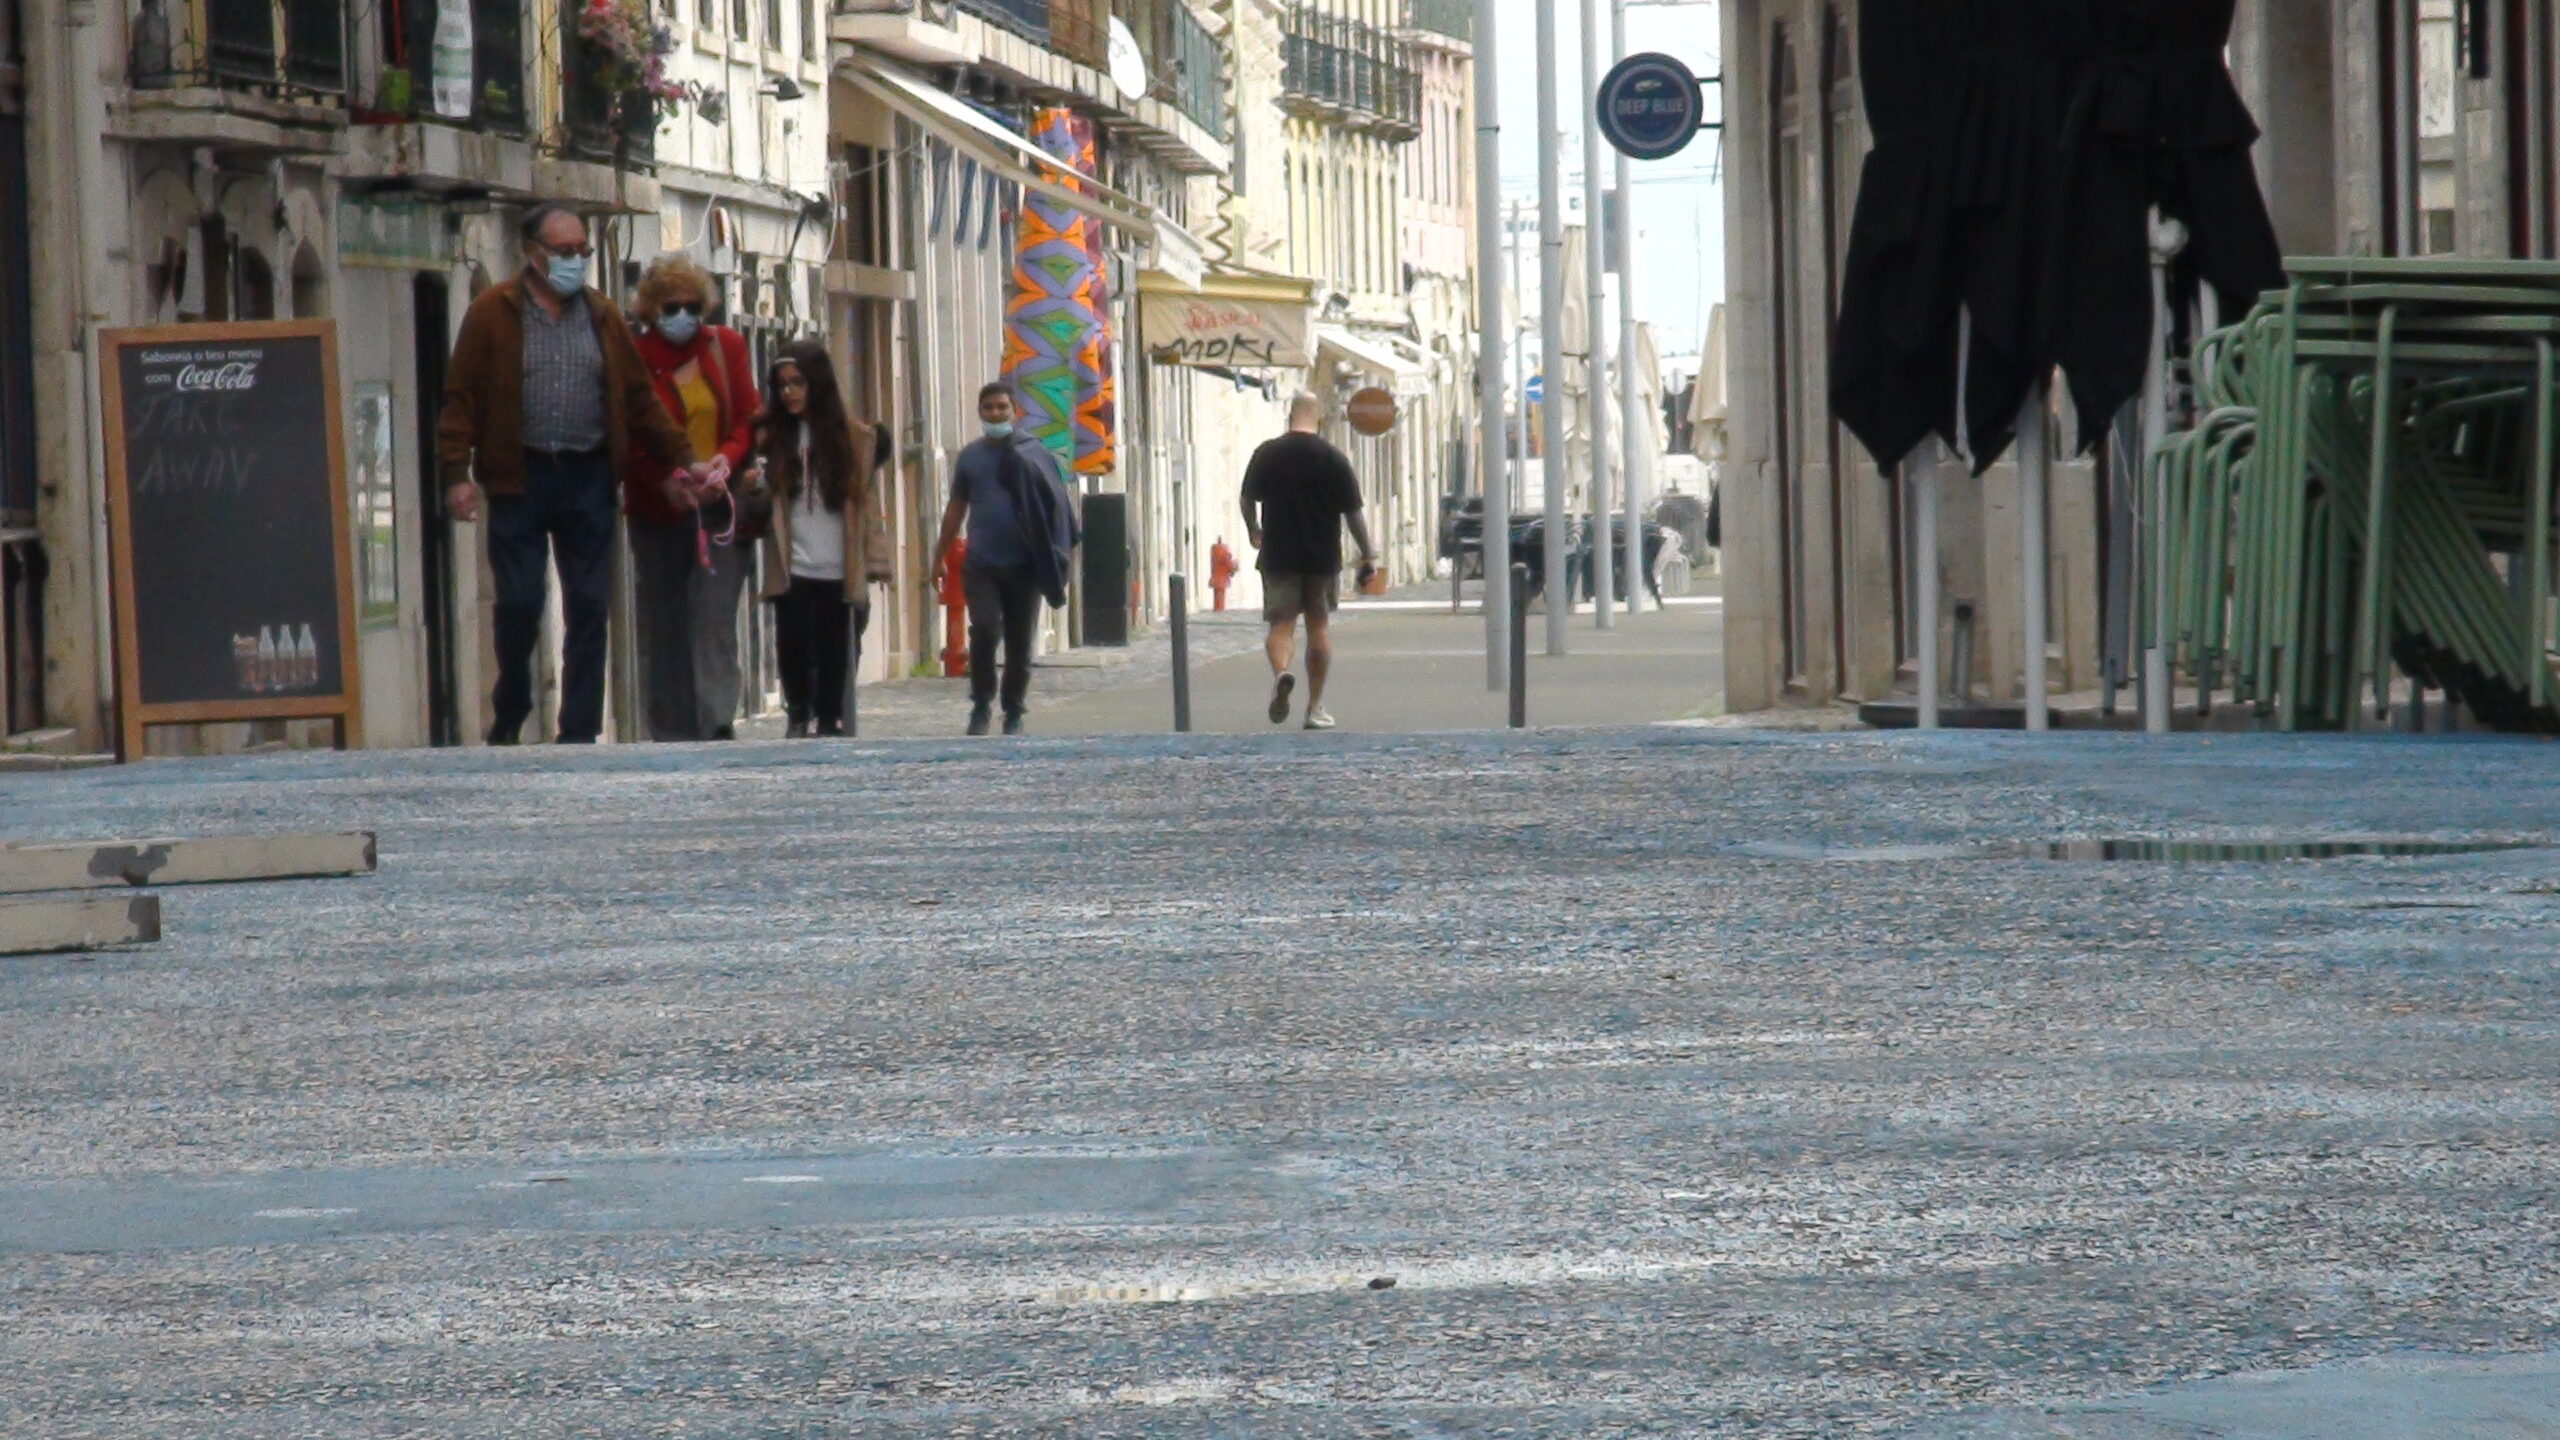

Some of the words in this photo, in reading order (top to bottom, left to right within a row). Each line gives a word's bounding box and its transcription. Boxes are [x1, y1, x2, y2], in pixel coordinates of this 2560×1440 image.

[1617, 98, 1649, 115] DEEP
[1651, 97, 1685, 113] BLUE
[145, 374, 172, 384] com
